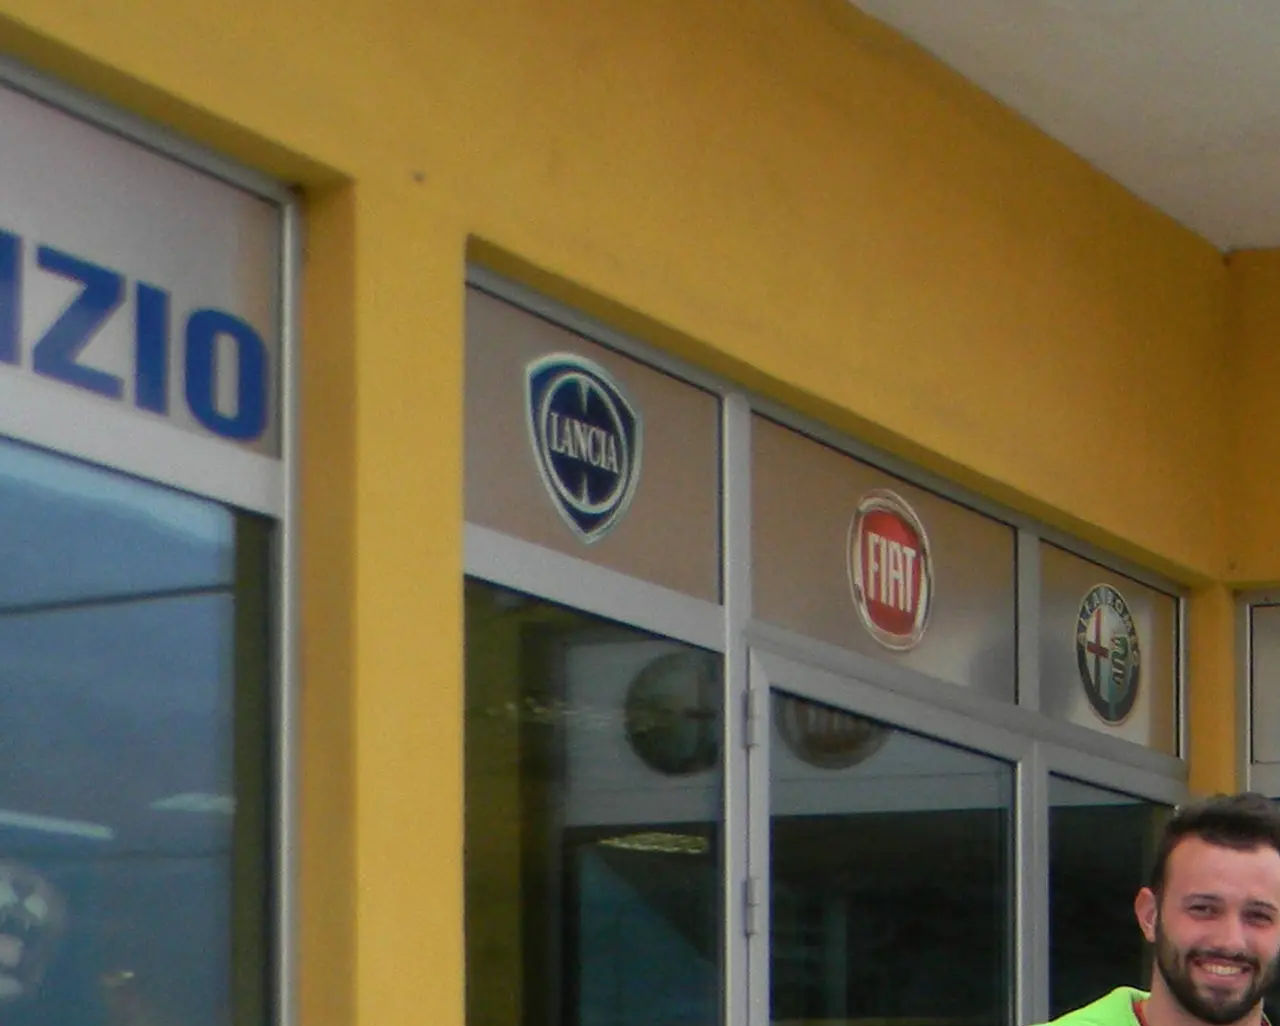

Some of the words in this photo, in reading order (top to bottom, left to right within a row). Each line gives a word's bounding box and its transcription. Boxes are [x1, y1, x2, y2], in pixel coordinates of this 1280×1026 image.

[0, 228, 269, 443] IZIO
[550, 411, 619, 475] LANCIA
[867, 530, 917, 613] FIAT
